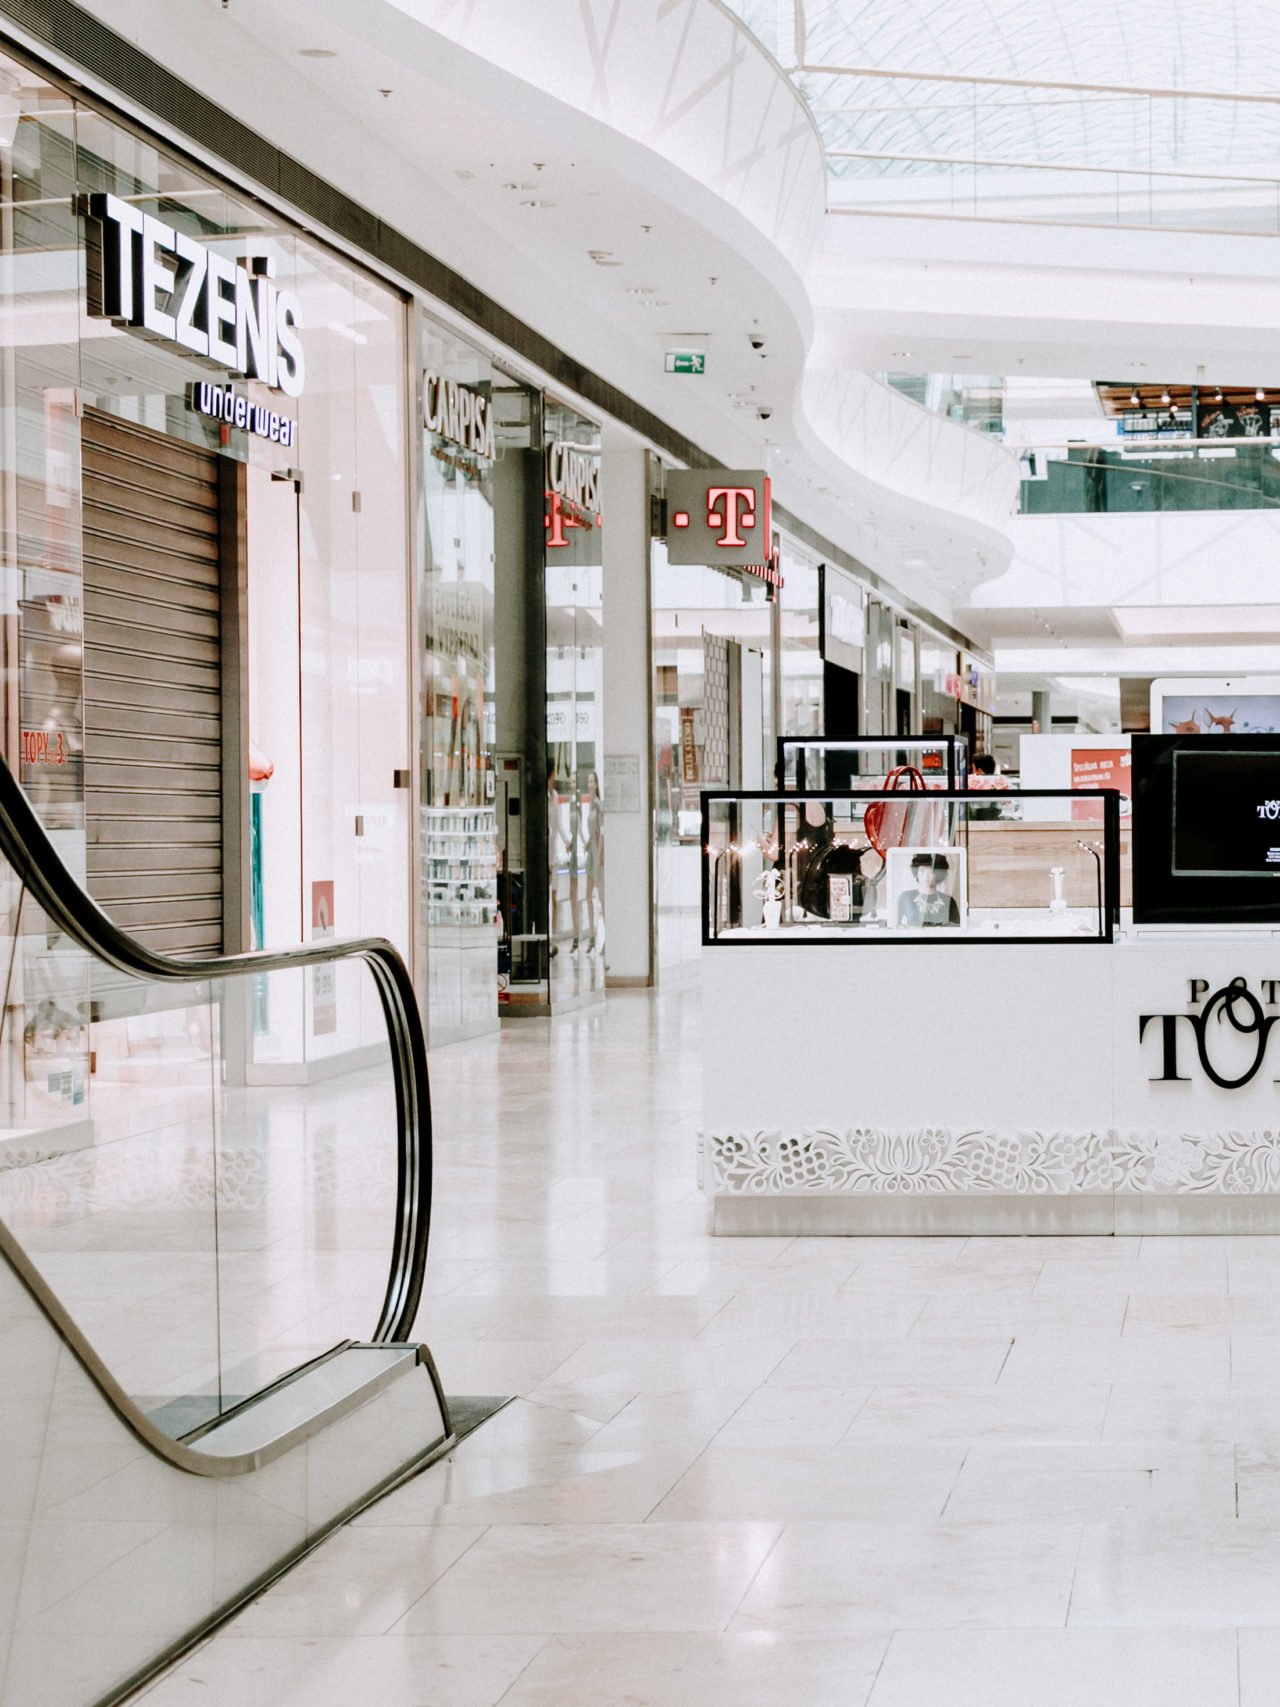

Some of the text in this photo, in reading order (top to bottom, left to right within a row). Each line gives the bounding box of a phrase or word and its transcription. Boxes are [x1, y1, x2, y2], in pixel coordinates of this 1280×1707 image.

[96, 193, 305, 397] TEZENIS
[197, 381, 298, 447] underwear
[423, 368, 496, 462] CARPISA
[23, 731, 49, 764] TOPY
